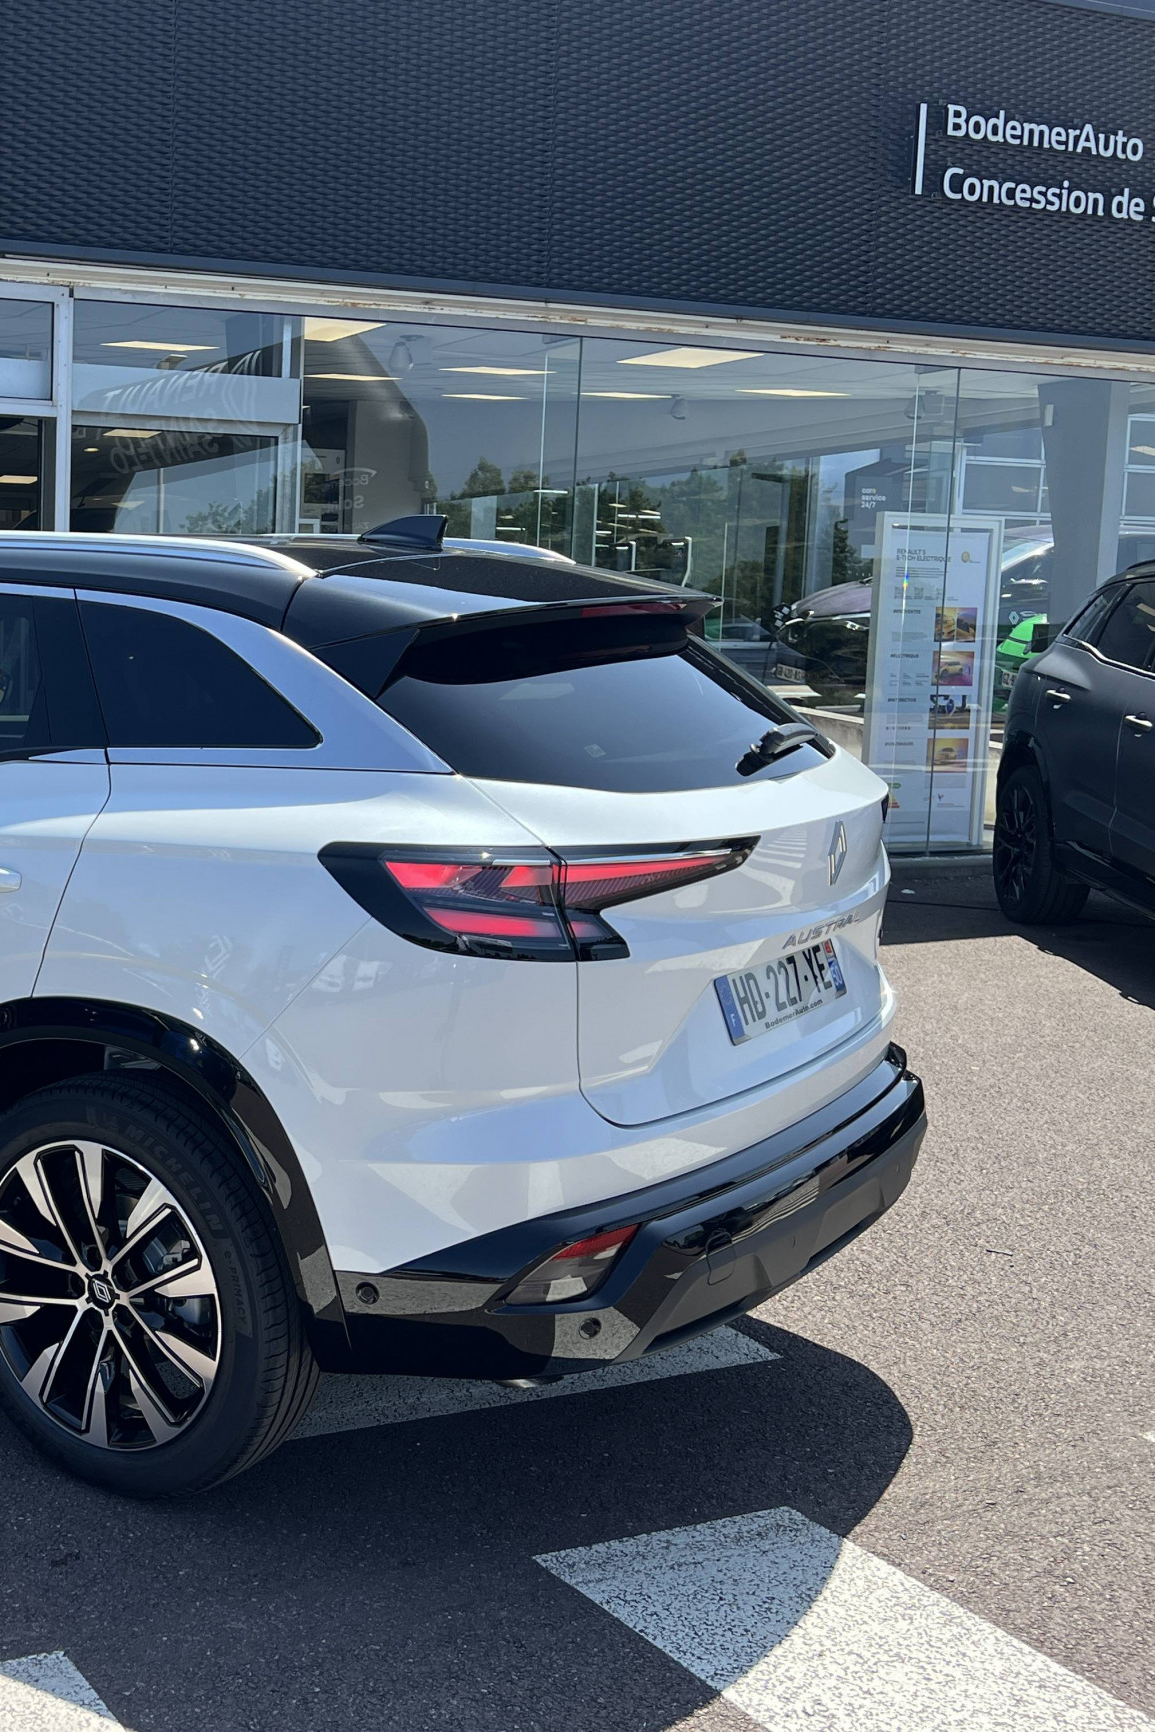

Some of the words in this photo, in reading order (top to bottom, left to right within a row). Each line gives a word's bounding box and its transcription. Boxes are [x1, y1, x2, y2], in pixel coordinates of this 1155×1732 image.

[946, 103, 1144, 162] BodemerAuto
[942, 167, 1105, 217] Concession
[1111, 187, 1146, 222] de
[860, 501, 876, 509] 24/7
[782, 911, 862, 950] AUSTRAL
[729, 1013, 737, 1027] F
[764, 998, 823, 1030] BodemerAuto.com
[124, 1124, 224, 1232] MICHELIN
